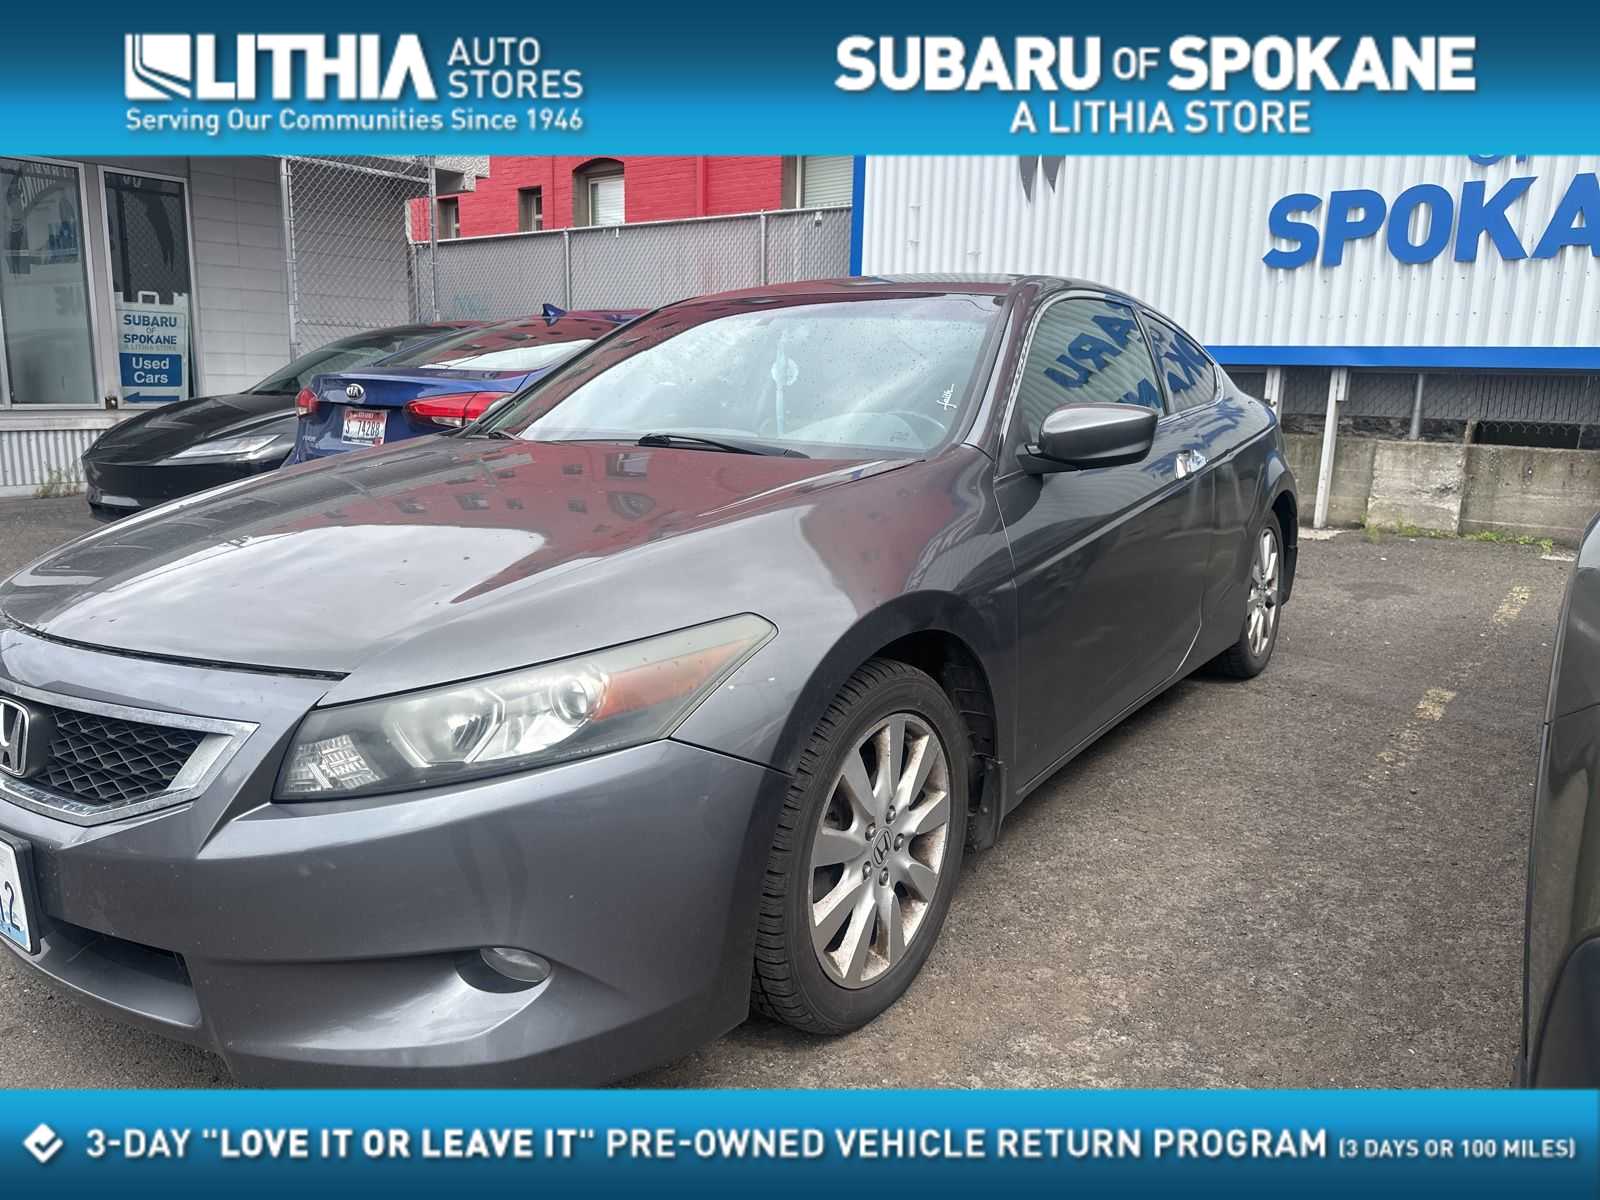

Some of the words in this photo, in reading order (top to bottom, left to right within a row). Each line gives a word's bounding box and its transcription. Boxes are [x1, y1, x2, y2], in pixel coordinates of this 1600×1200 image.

[123, 314, 177, 327] SUBARU
[123, 334, 177, 345] SPOKANE
[132, 356, 170, 369] Used
[134, 371, 168, 384] Cars
